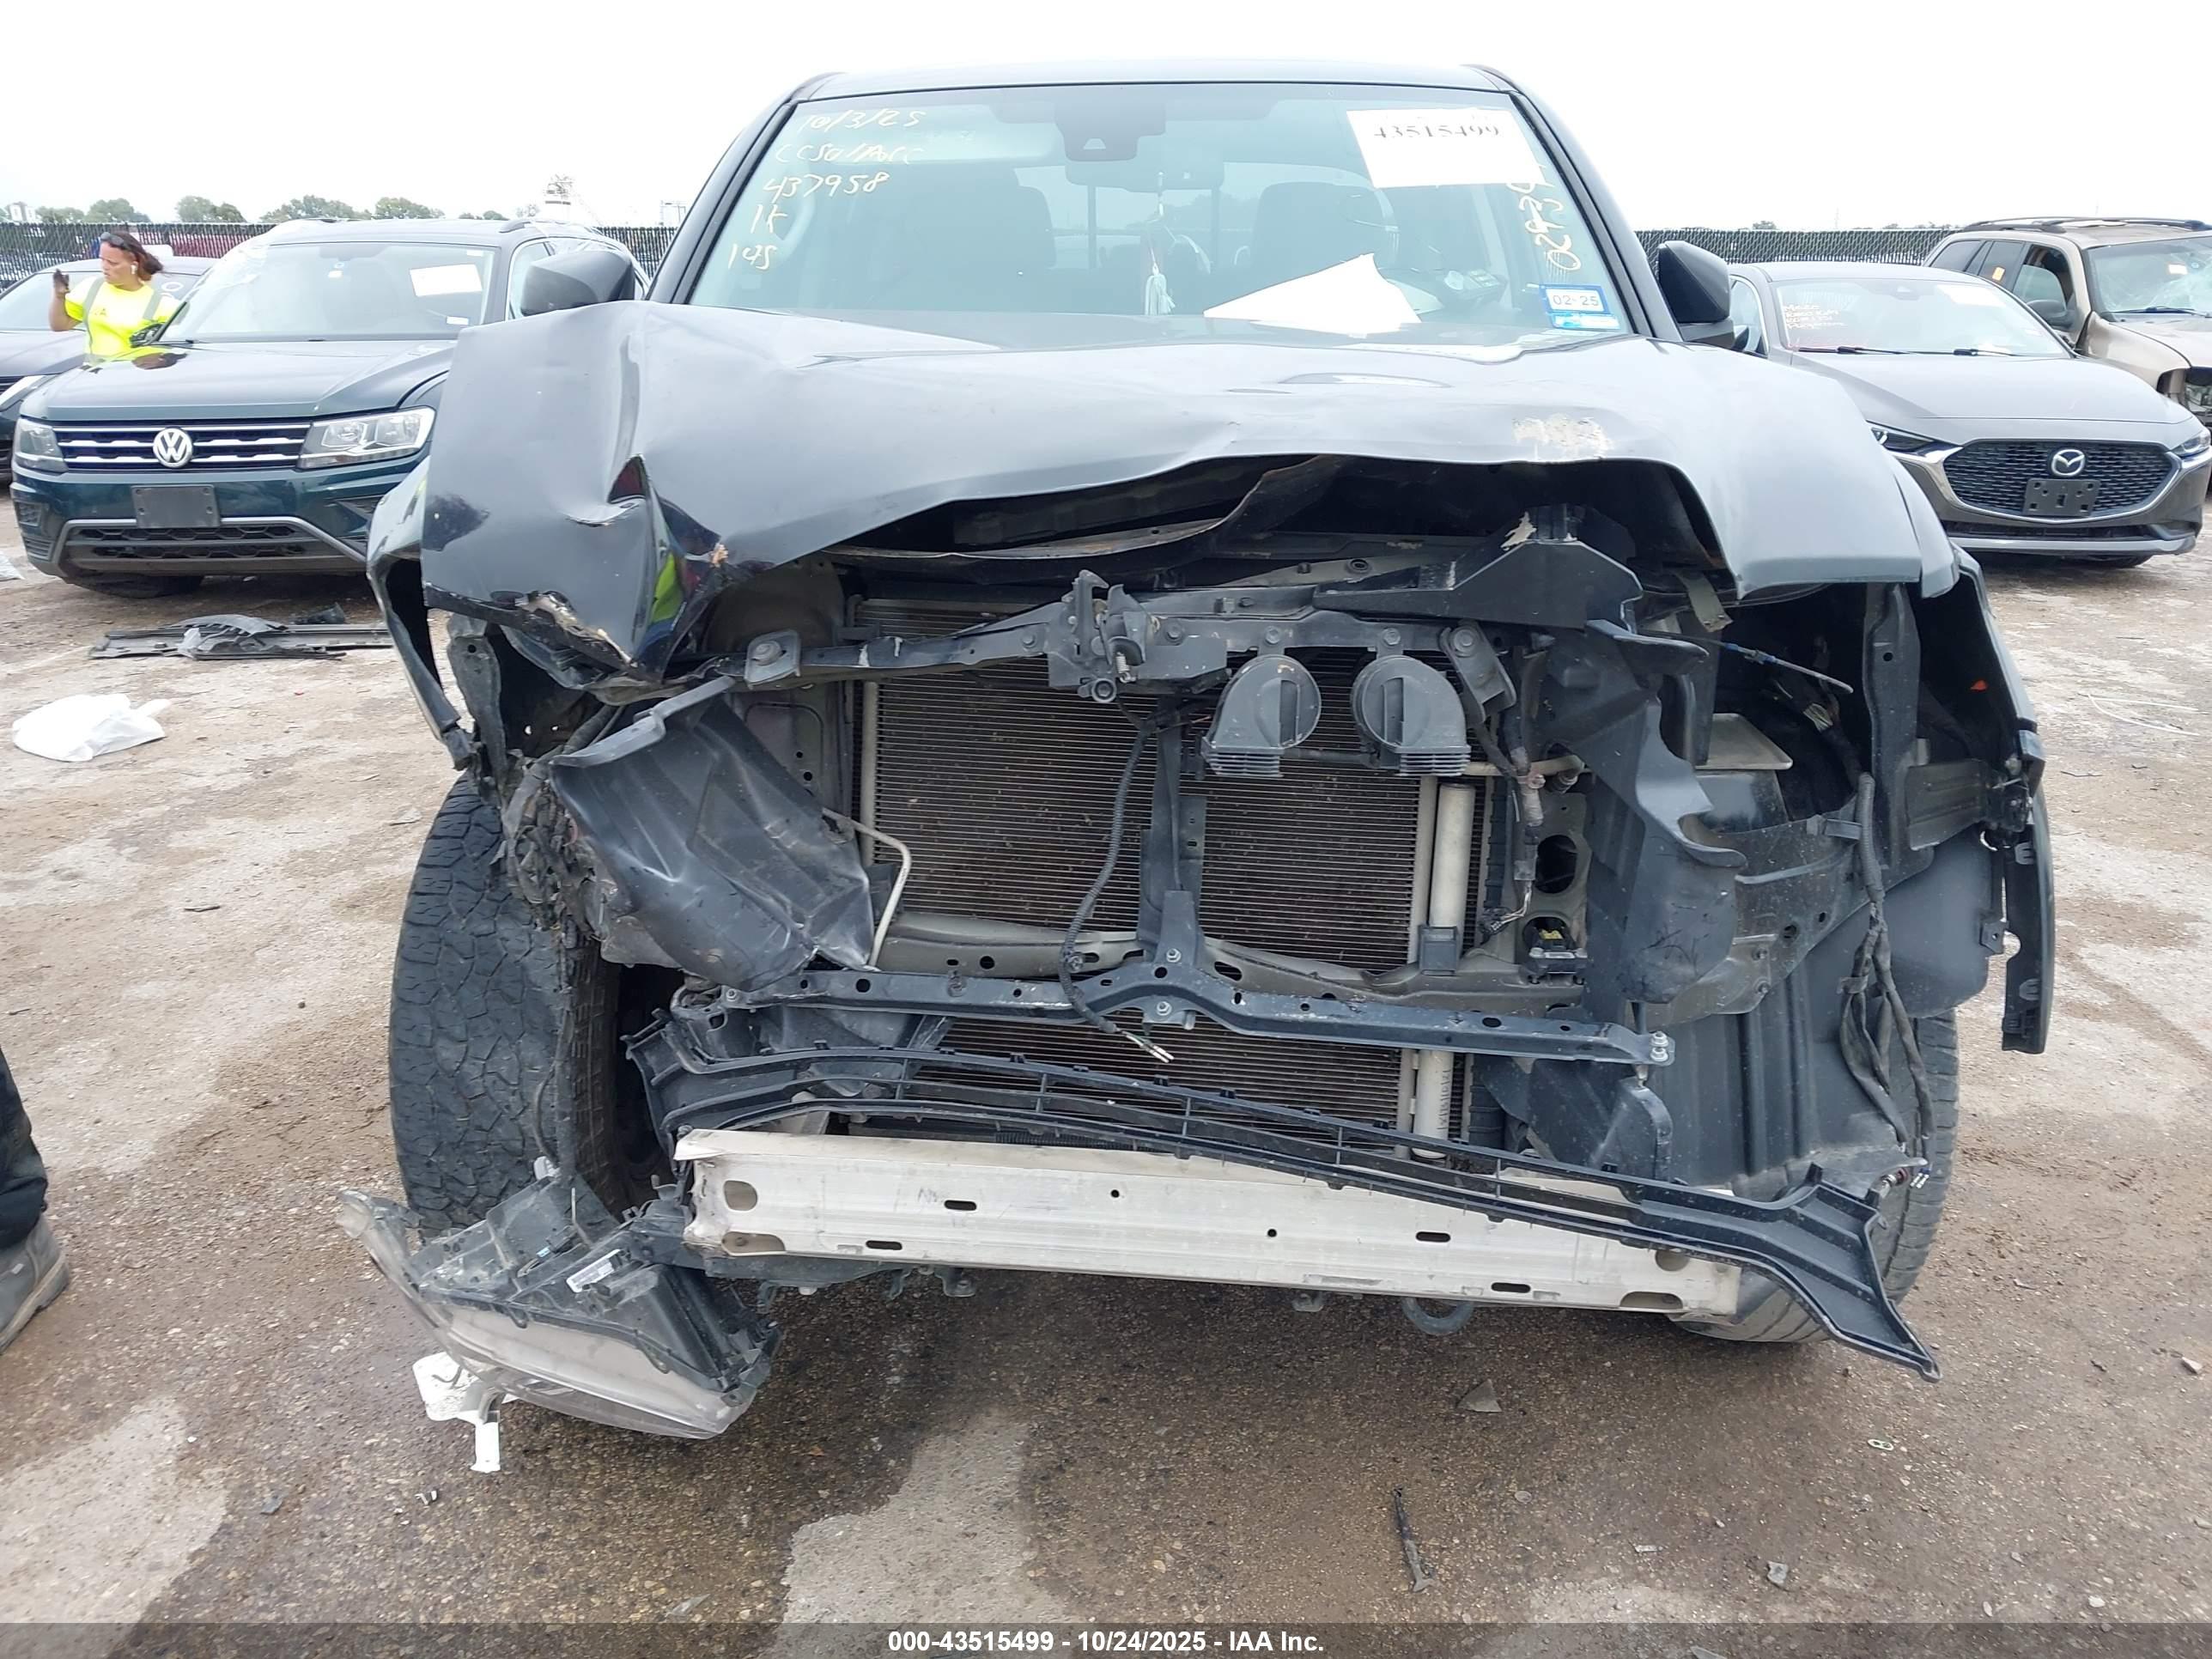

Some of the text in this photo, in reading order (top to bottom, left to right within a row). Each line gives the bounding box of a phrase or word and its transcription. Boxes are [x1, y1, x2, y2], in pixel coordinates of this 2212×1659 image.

[799, 108, 926, 131] 10/3/25
[1374, 124, 1501, 139] 43515499
[763, 171, 890, 204] 437958
